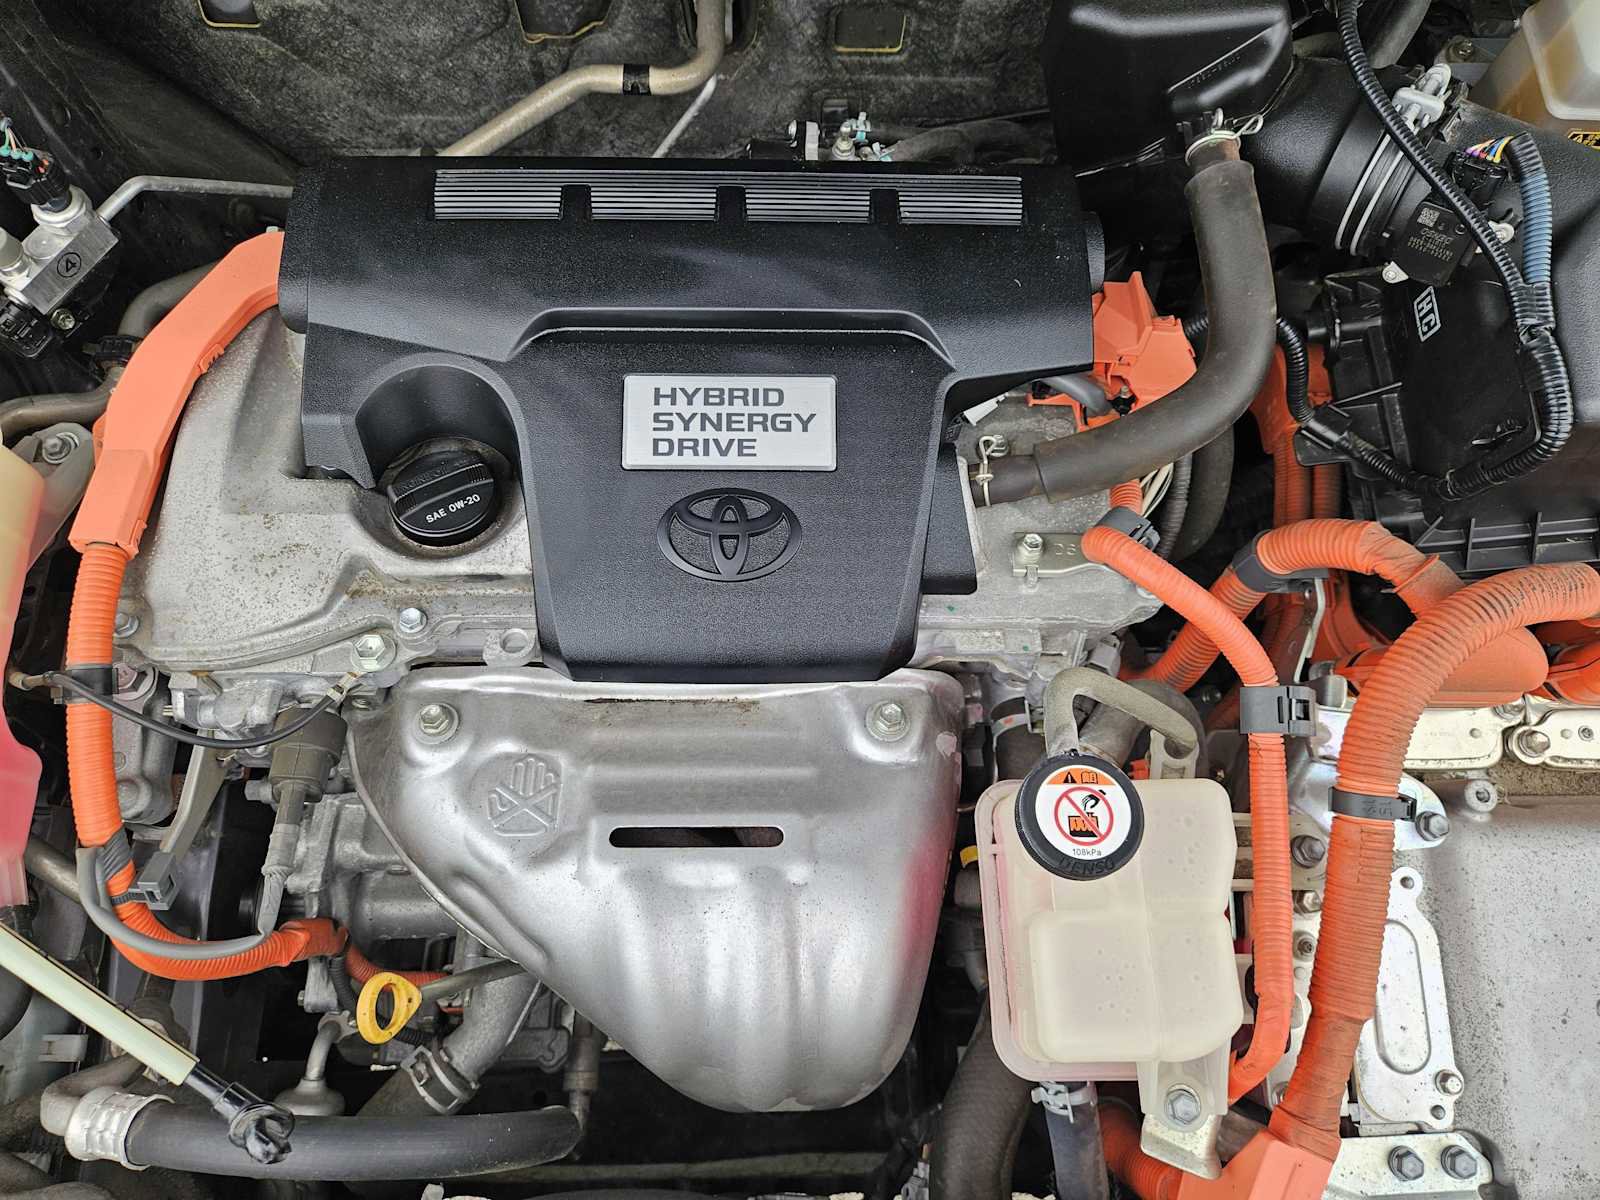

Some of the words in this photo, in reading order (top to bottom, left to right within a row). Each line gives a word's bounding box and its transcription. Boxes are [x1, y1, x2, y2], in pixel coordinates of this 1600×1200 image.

[653, 387, 785, 407] HYBRID
[652, 412, 817, 433] SYNERGY
[652, 438, 757, 457] DRIVE
[425, 508, 447, 523] SAE
[448, 494, 481, 513] 0W-20
[1072, 848, 1102, 857] 108kPa
[1059, 857, 1115, 875] DENSO
